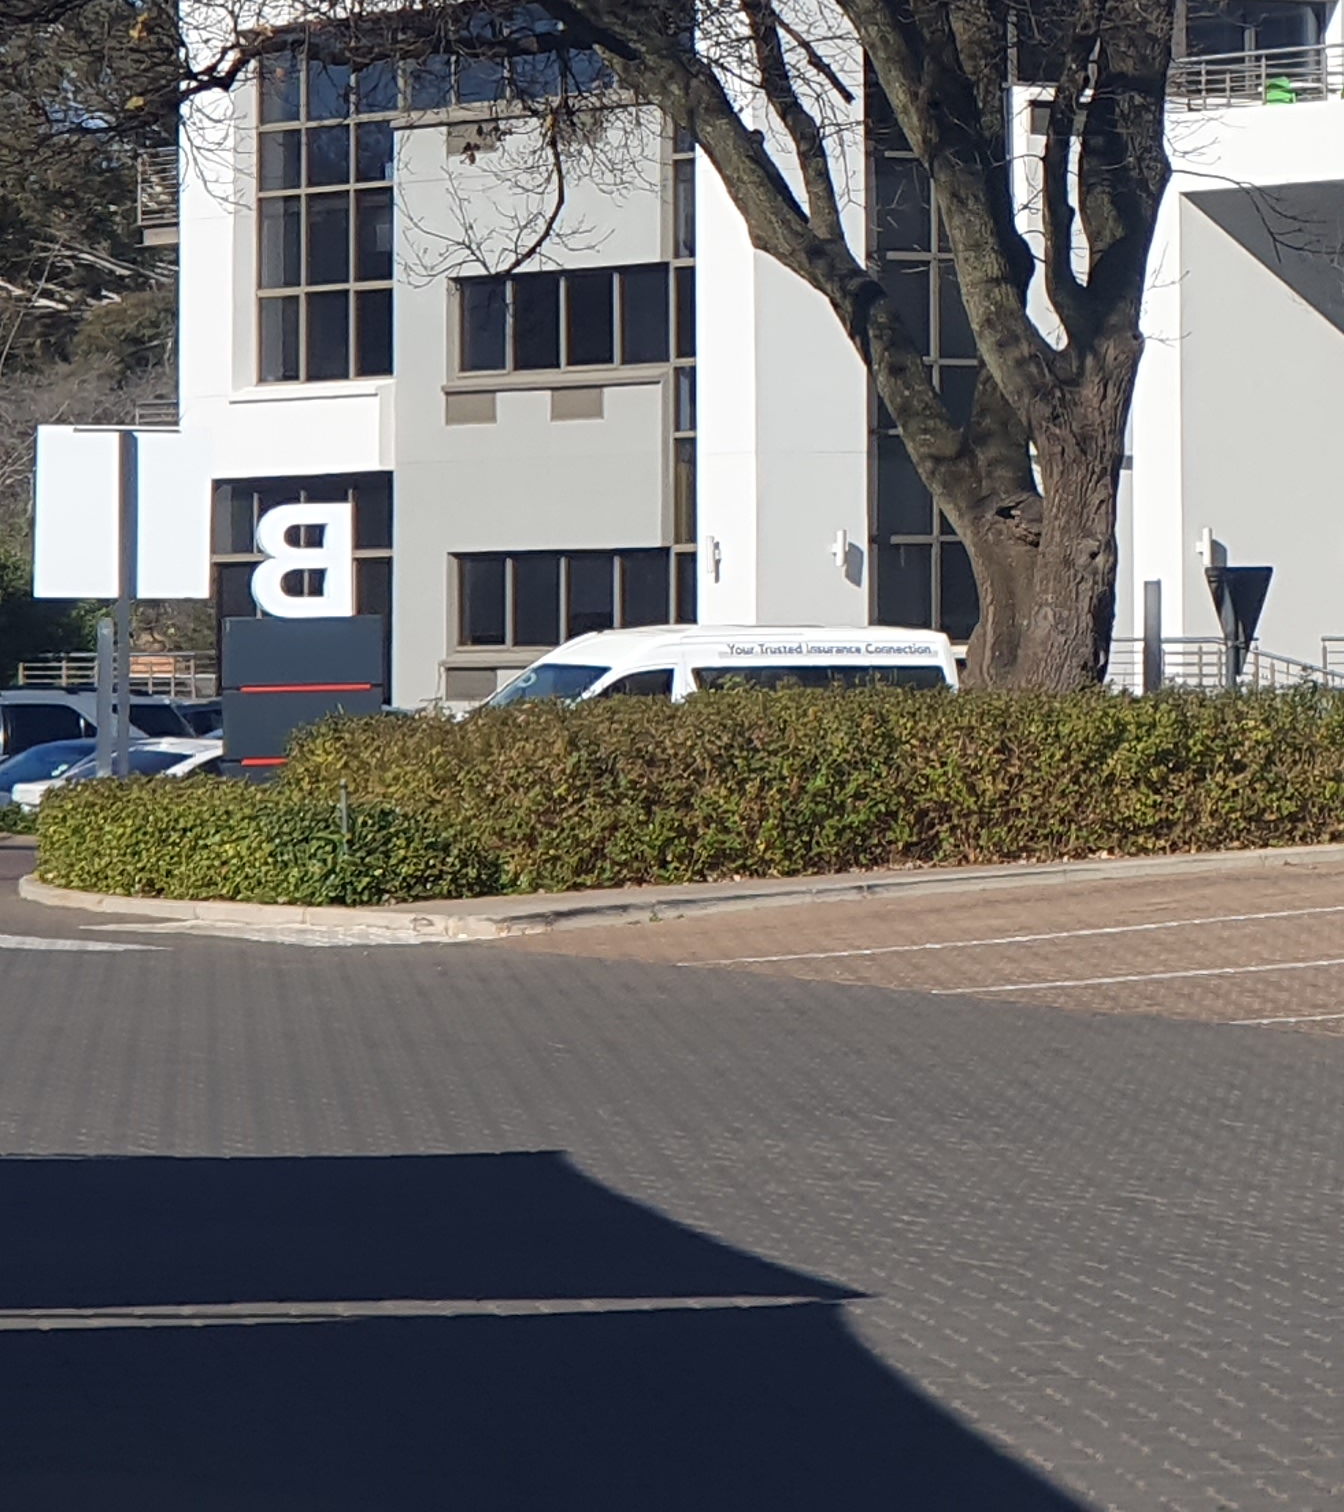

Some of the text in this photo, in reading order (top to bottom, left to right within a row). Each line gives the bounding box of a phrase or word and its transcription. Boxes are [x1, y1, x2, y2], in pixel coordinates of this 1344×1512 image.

[727, 642, 932, 655] Your Trusted Insurance Connection
